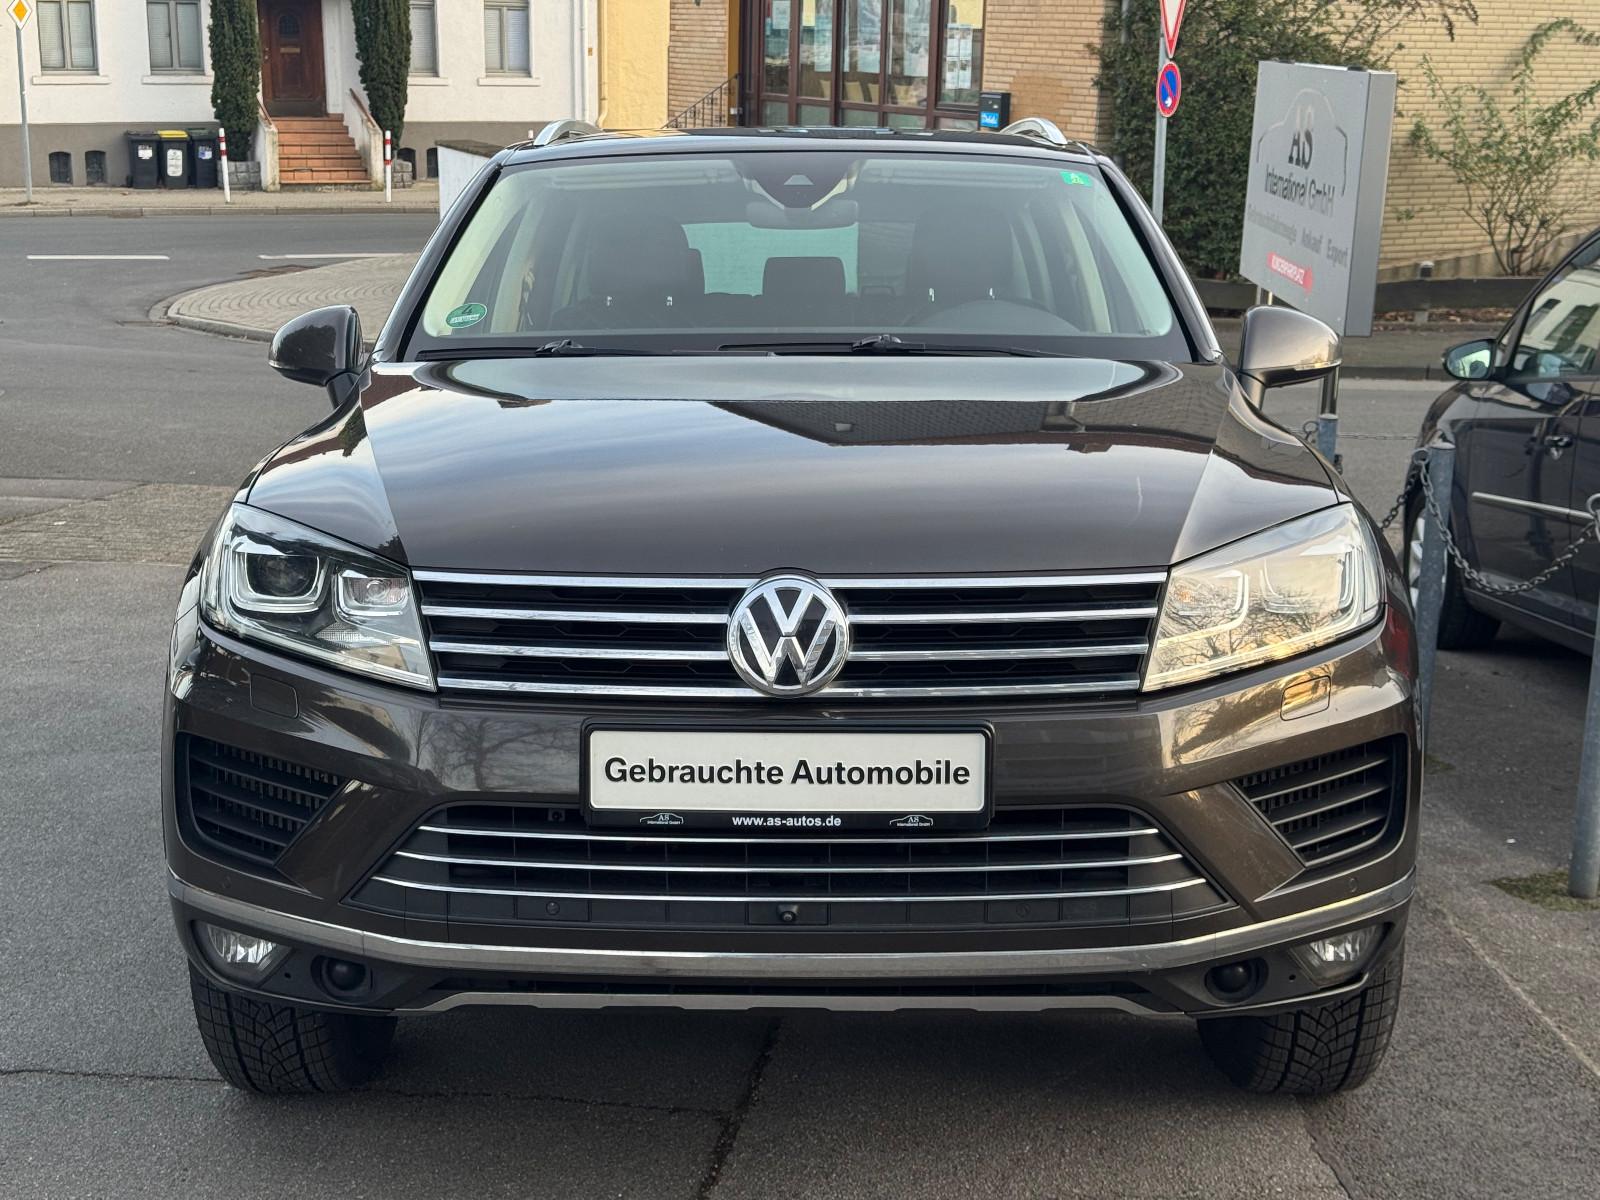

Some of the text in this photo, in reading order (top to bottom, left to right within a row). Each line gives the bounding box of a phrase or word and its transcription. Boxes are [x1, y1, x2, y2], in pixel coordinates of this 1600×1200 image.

[1287, 104, 1314, 170] AS
[1265, 164, 1335, 217] International GmbH
[461, 304, 473, 315] 4
[604, 756, 970, 785] Gebrauchte Automobile
[732, 815, 842, 827] www.as-autos.de
